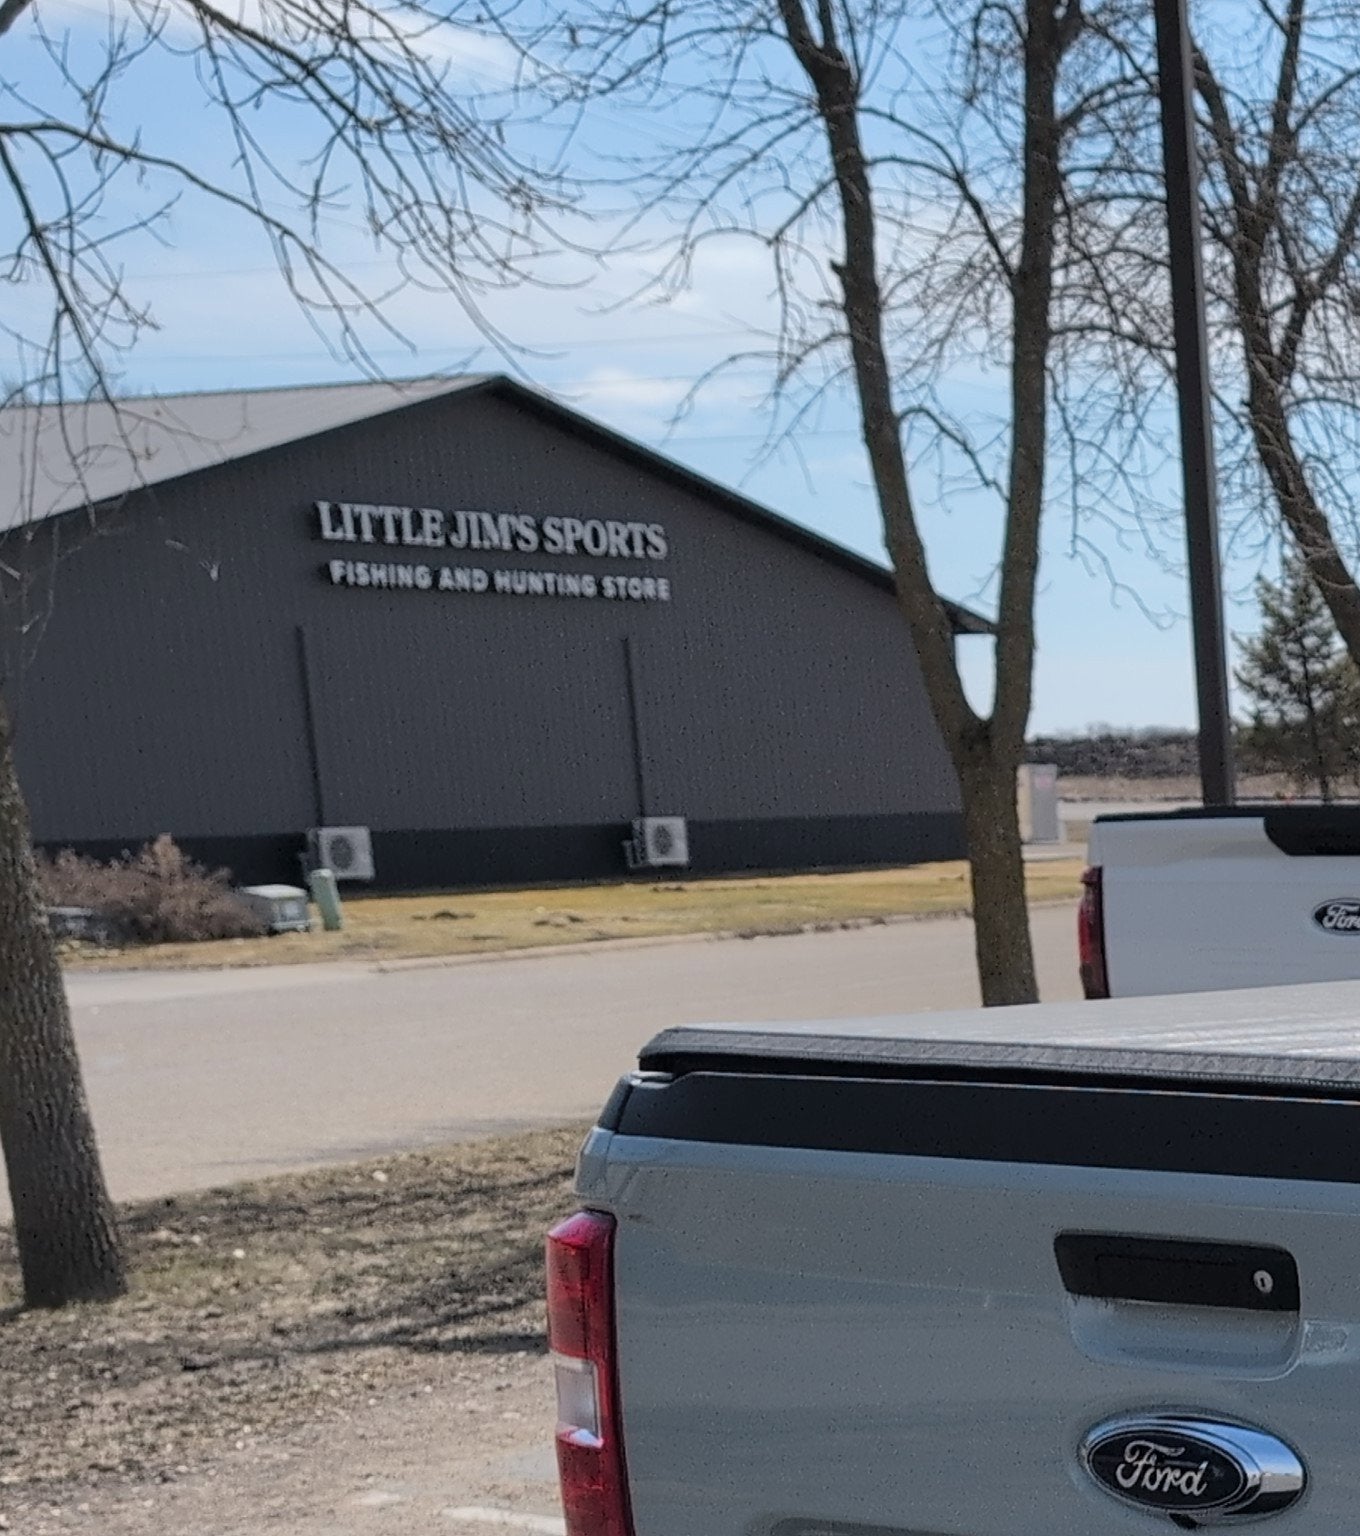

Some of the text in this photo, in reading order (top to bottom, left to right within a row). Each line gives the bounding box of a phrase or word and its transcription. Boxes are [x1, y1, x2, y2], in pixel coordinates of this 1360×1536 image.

[316, 501, 668, 560] LITTLE JIM'S SPORTS
[328, 558, 671, 601] FISHING AND HUNTING STORE
[1116, 1440, 1208, 1497] Ford
